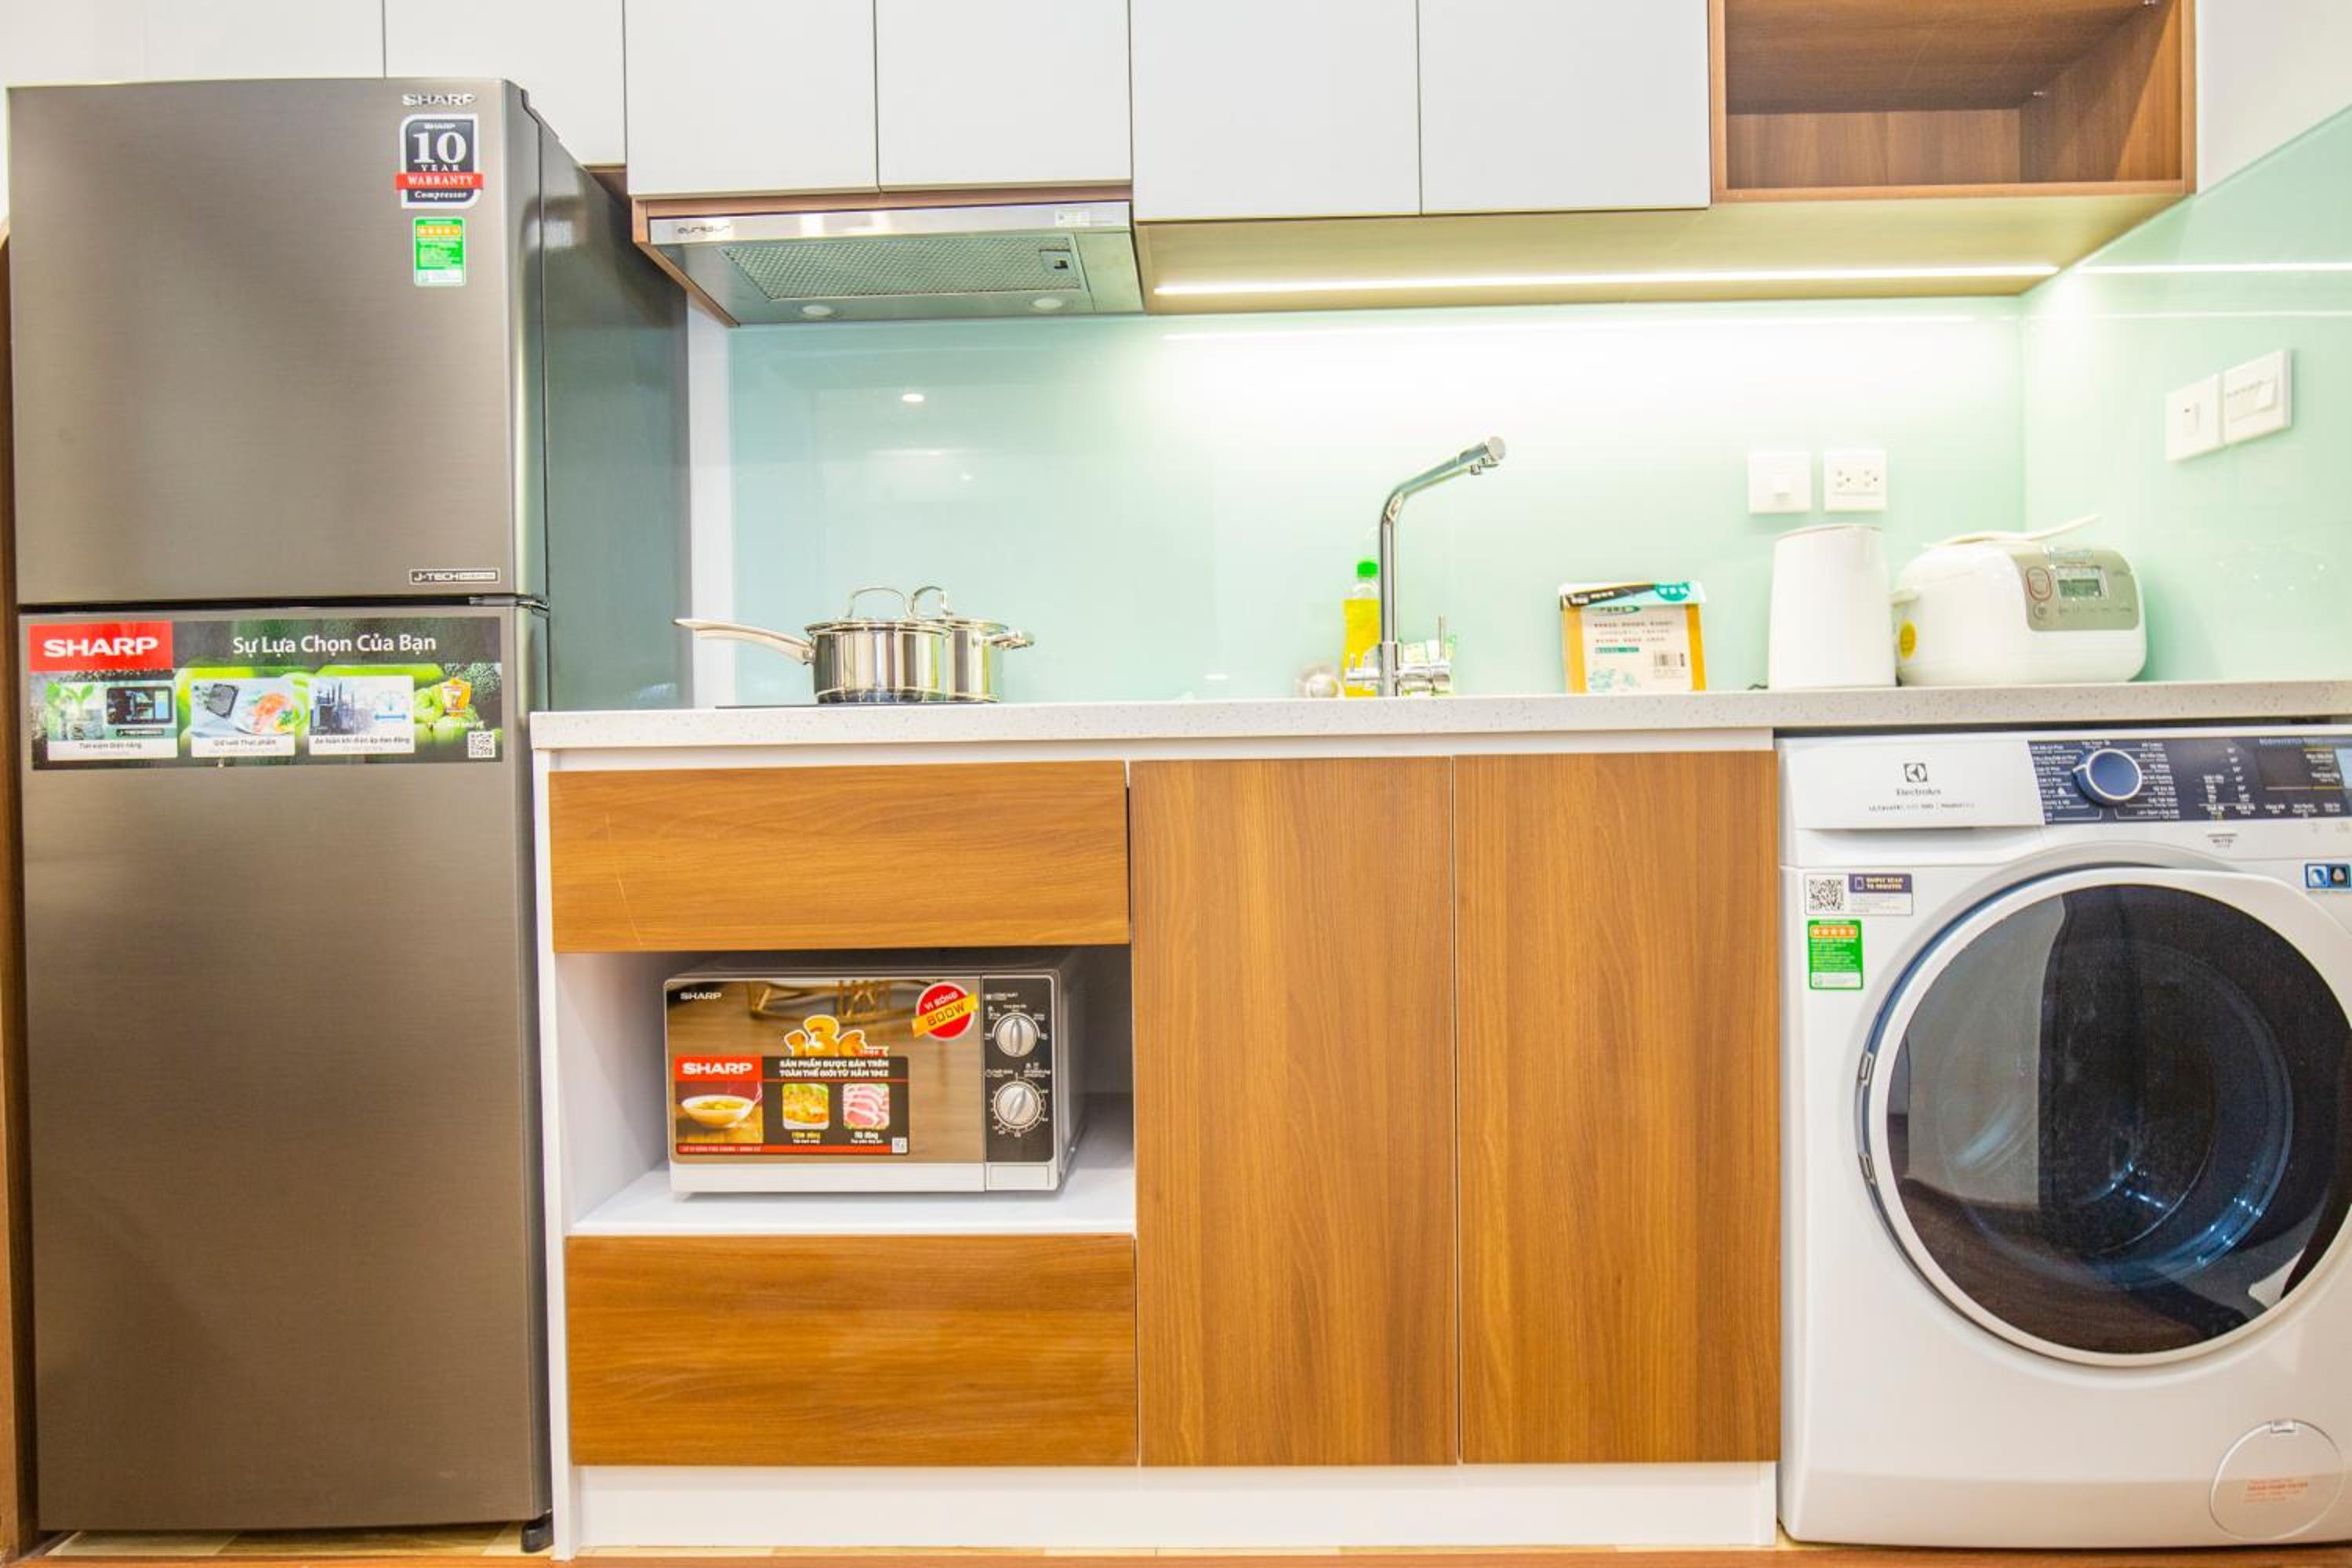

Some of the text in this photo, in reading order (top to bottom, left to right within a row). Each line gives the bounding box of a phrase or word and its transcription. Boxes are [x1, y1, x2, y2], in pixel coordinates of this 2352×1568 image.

[401, 93, 477, 106] SHARP
[413, 131, 466, 164] 10
[407, 175, 474, 186] WARRANTY
[414, 190, 467, 200] Compressor
[43, 636, 158, 658] SHARP
[233, 631, 437, 658] Sự Lựa Chọn Của Bạn
[680, 991, 722, 1000] SHARP
[927, 1002, 965, 1026] 800W
[681, 1062, 753, 1075] SHARP
